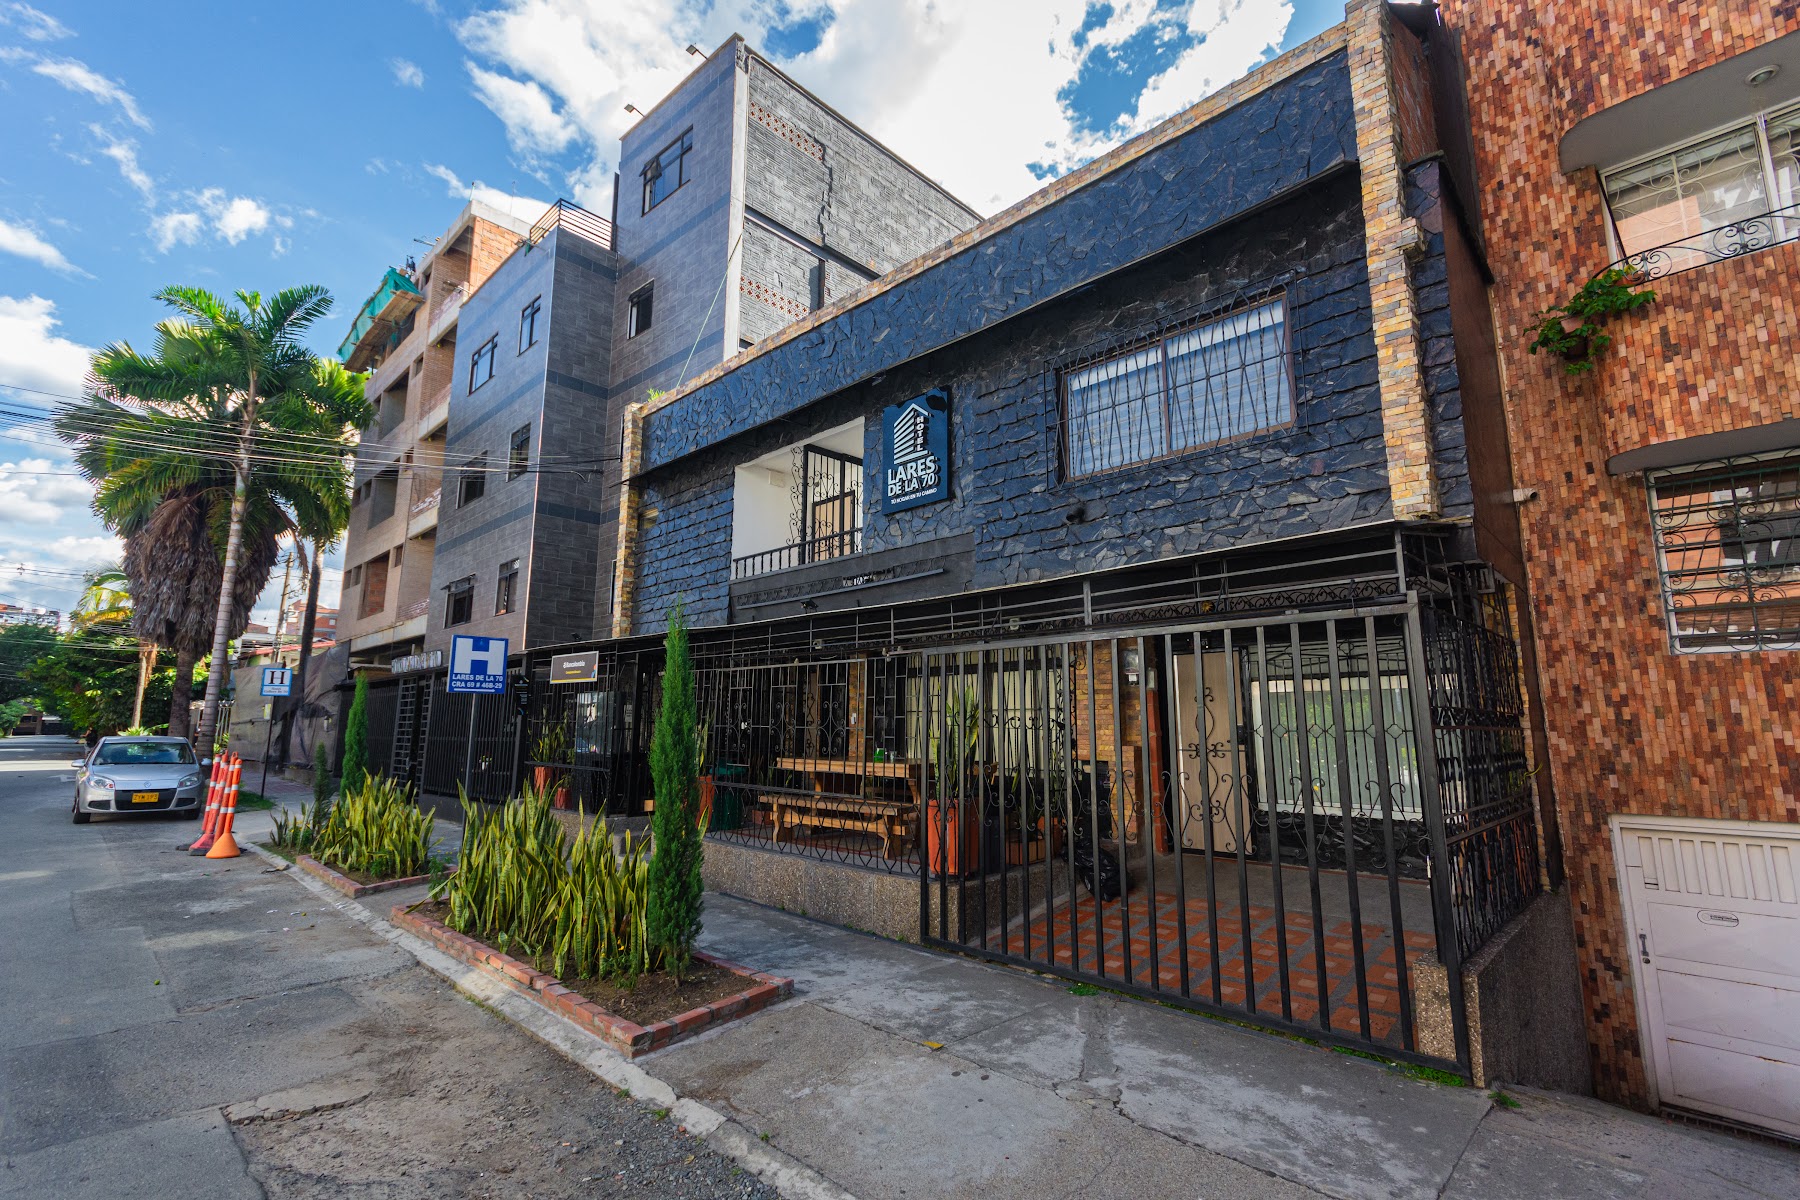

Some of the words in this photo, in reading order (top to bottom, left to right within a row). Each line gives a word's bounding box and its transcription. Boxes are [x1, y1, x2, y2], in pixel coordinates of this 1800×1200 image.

[916, 415, 925, 452] HOTEL
[888, 456, 936, 485] LARES
[888, 482, 902, 497] DE
[905, 479, 919, 492] LA
[922, 473, 935, 487] 70
[453, 637, 505, 675] H
[268, 670, 287, 685] H
